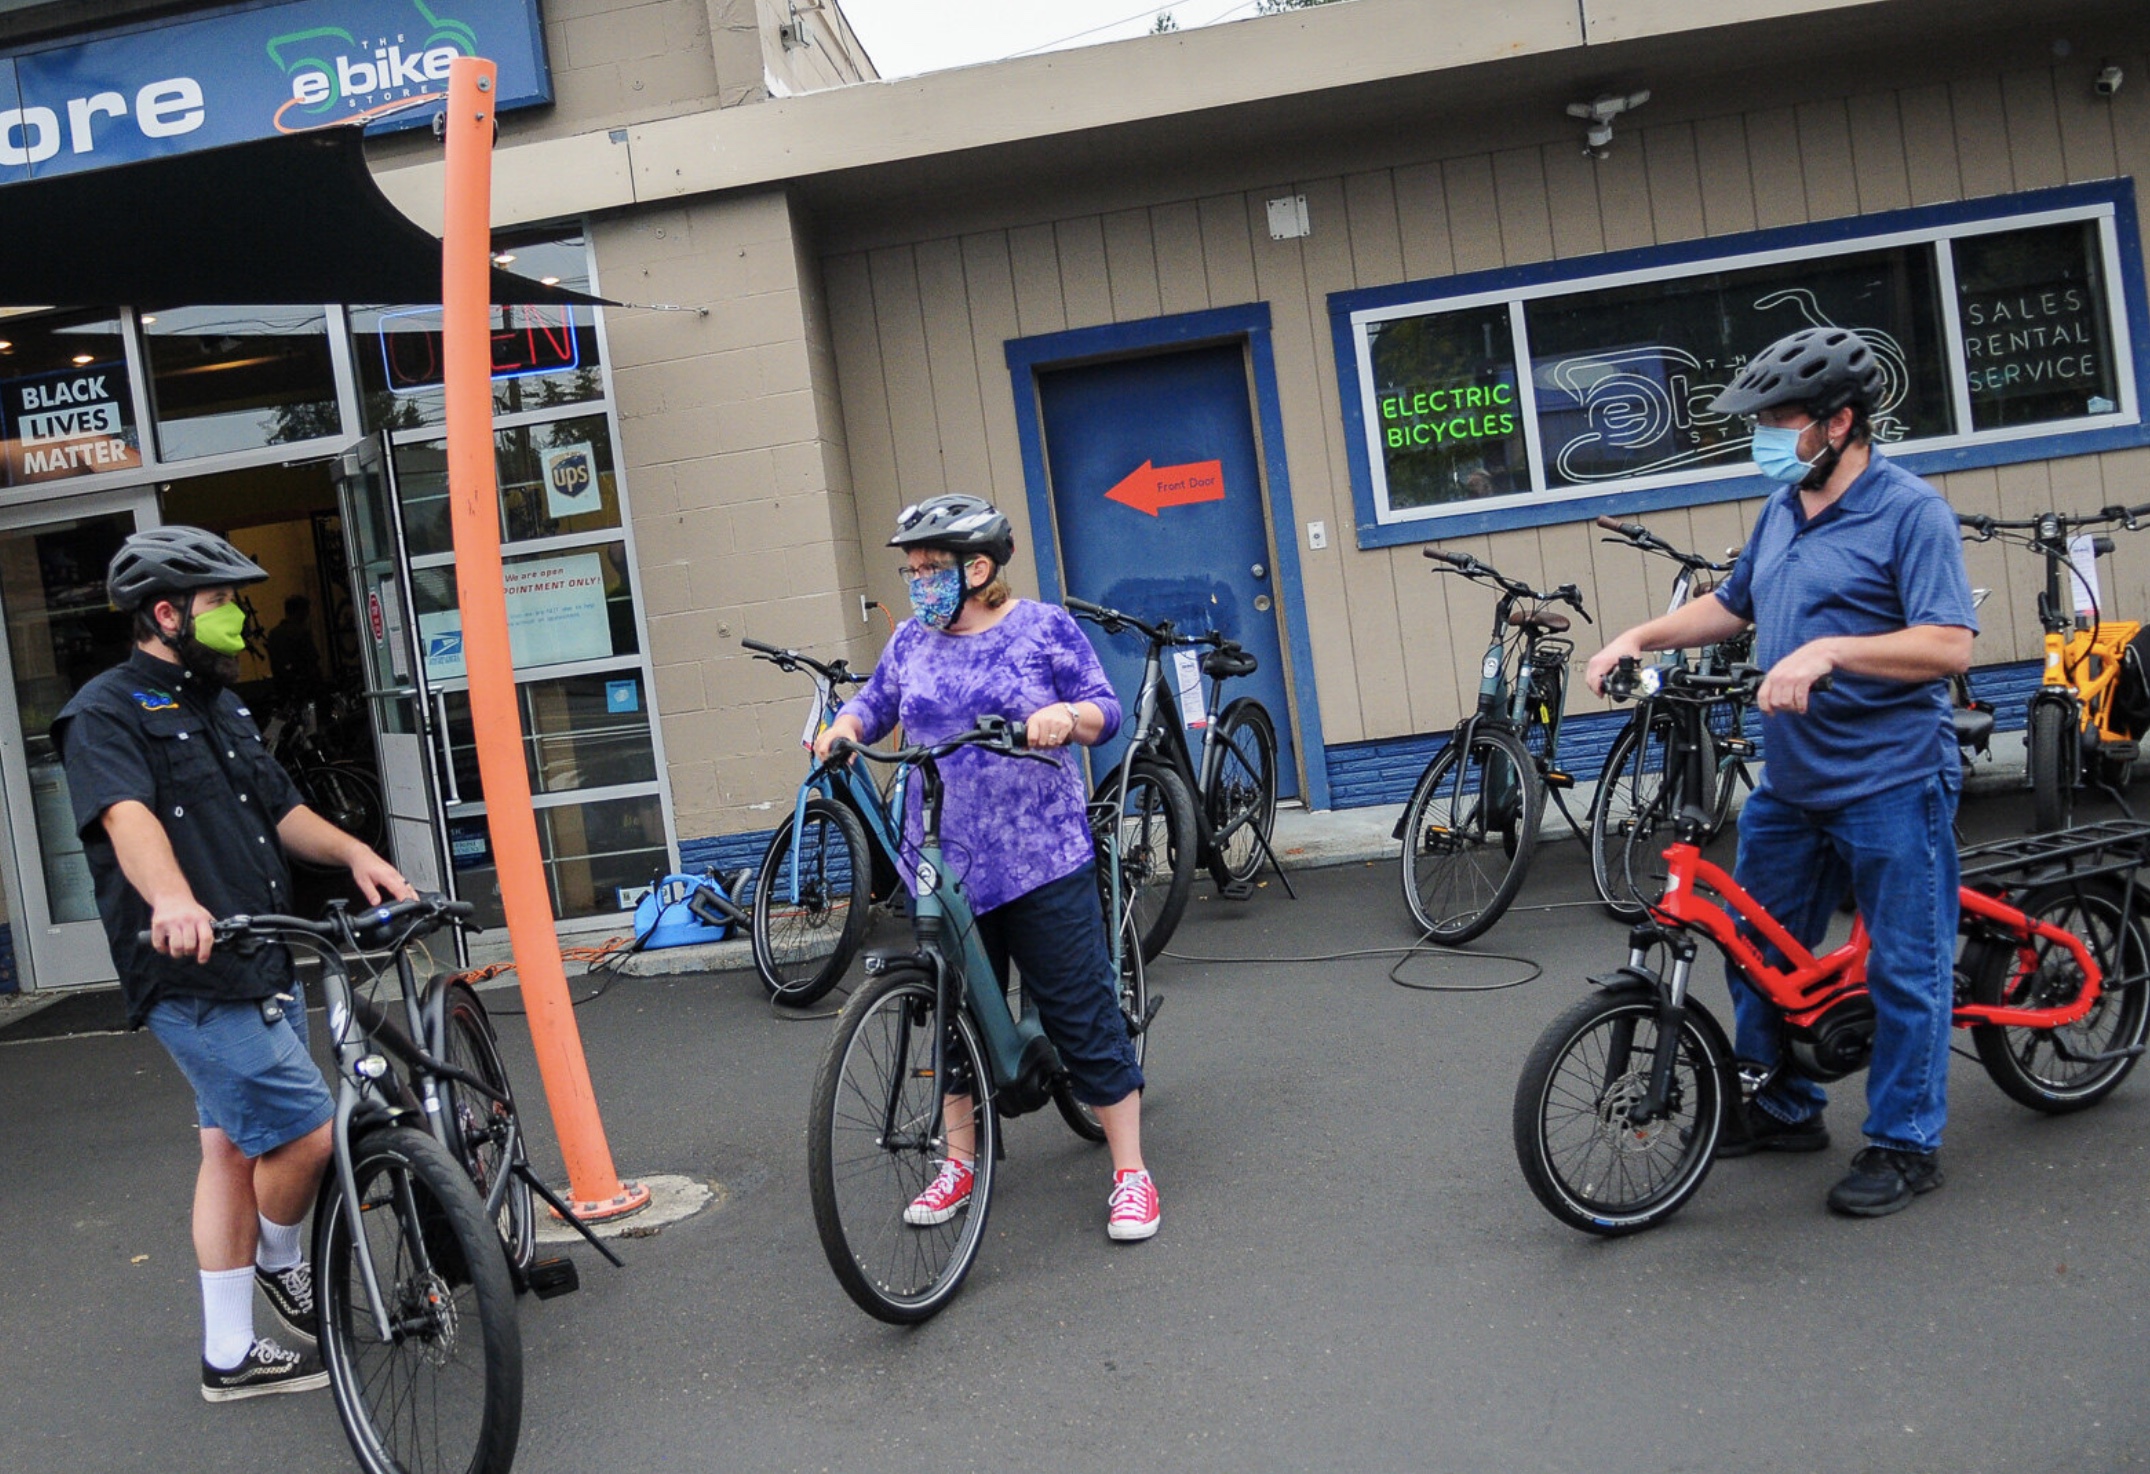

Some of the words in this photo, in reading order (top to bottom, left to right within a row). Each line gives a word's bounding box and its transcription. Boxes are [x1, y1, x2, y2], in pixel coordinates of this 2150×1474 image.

[361, 34, 405, 50] THE
[349, 85, 428, 108] STORE
[1969, 289, 2080, 325] SALES
[389, 304, 571, 383] OEN
[1965, 322, 2090, 359] RENTAL
[1968, 354, 2095, 392] SERVICE
[21, 375, 109, 410] BLACK
[1382, 384, 1512, 419] ELECTRIC
[30, 408, 109, 440] LIVES
[1387, 413, 1514, 448] BICYCLES
[24, 438, 128, 475] MATTER
[553, 465, 588, 492] ups
[1157, 481, 1185, 492] Front
[1189, 477, 1216, 488] Door
[521, 571, 537, 580] are
[540, 568, 564, 577] open
